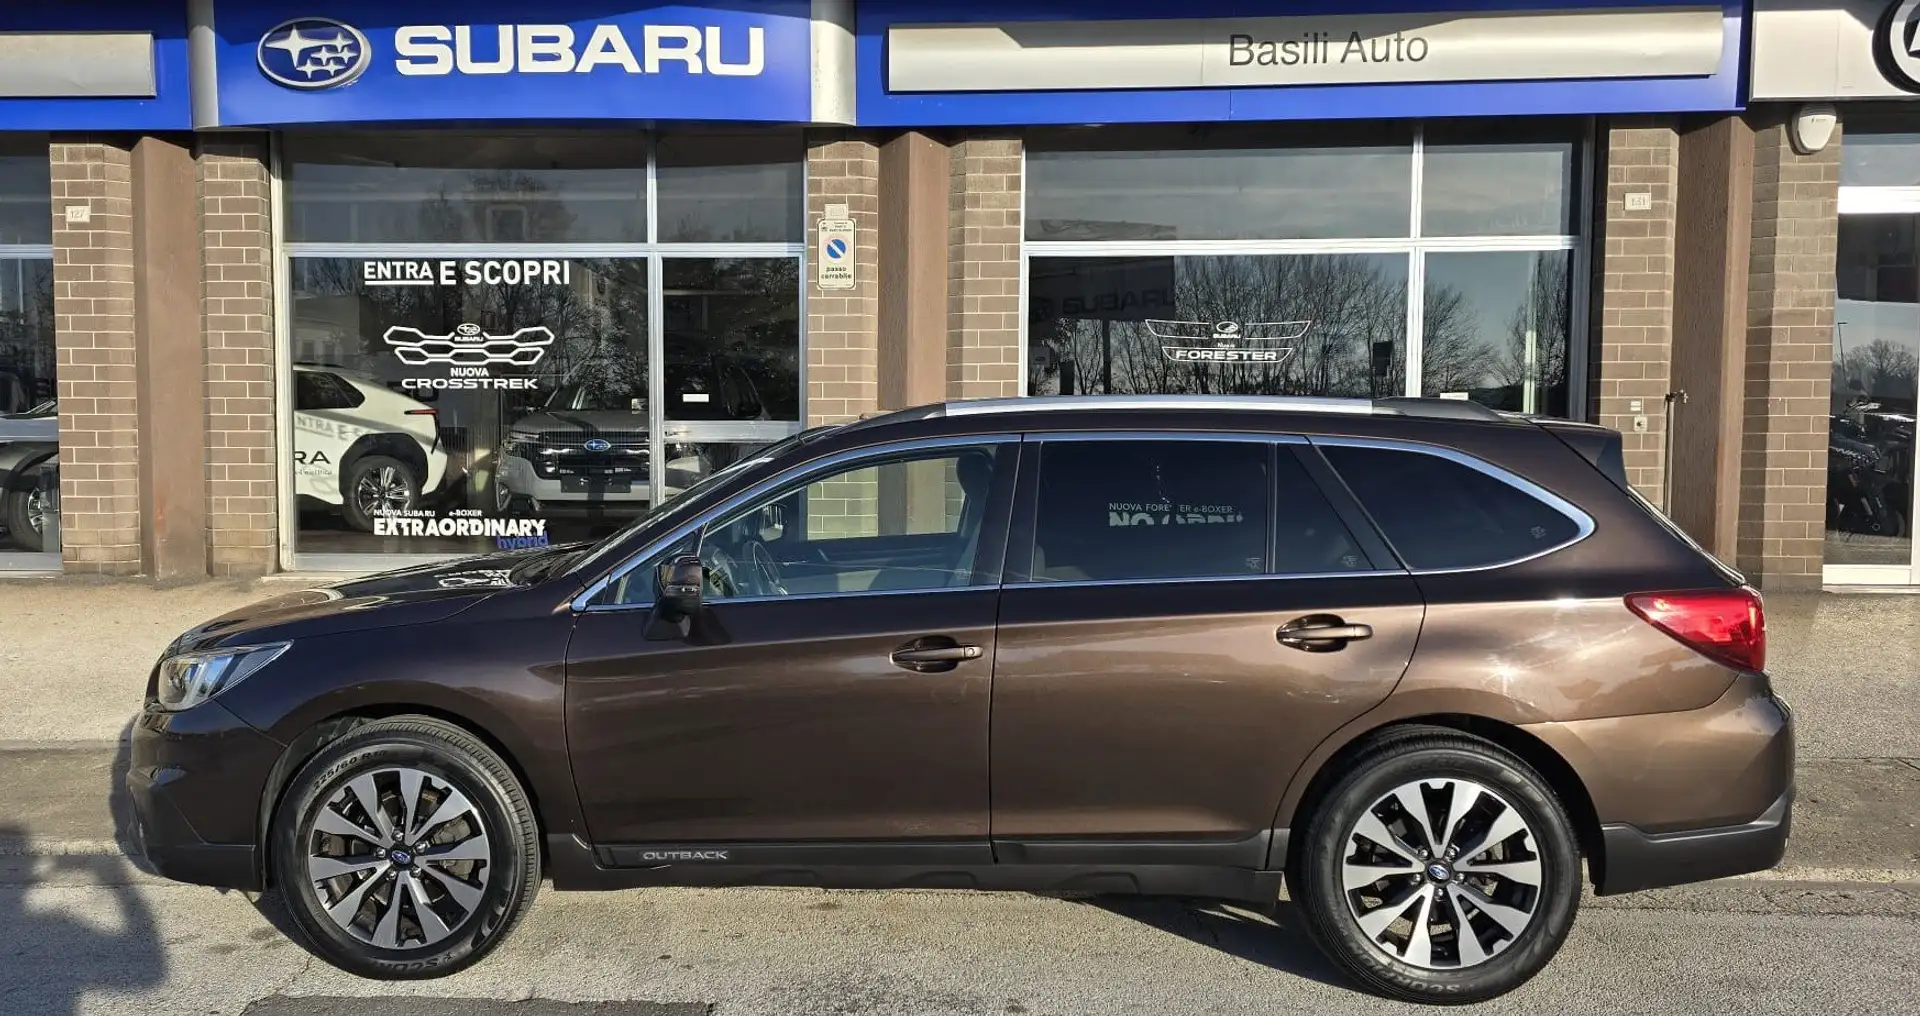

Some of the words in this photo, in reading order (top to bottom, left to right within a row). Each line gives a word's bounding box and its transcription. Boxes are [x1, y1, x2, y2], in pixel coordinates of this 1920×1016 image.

[395, 24, 764, 76] SUBARU
[1229, 32, 1328, 66] Basili
[1340, 31, 1429, 63] Auto
[364, 261, 434, 280] ENTRA
[440, 261, 456, 285] E
[464, 260, 570, 285] SCOPRI
[1176, 350, 1277, 360] FORESTER
[451, 368, 489, 377] NUOVA
[401, 378, 538, 389] CROSSTREK
[403, 509, 436, 517] SUBARU
[1109, 503, 1142, 512] NUOVA
[373, 518, 547, 536] EXTRAORDINARY
[497, 530, 549, 549] hybrid
[643, 850, 728, 860] OUTBACK
